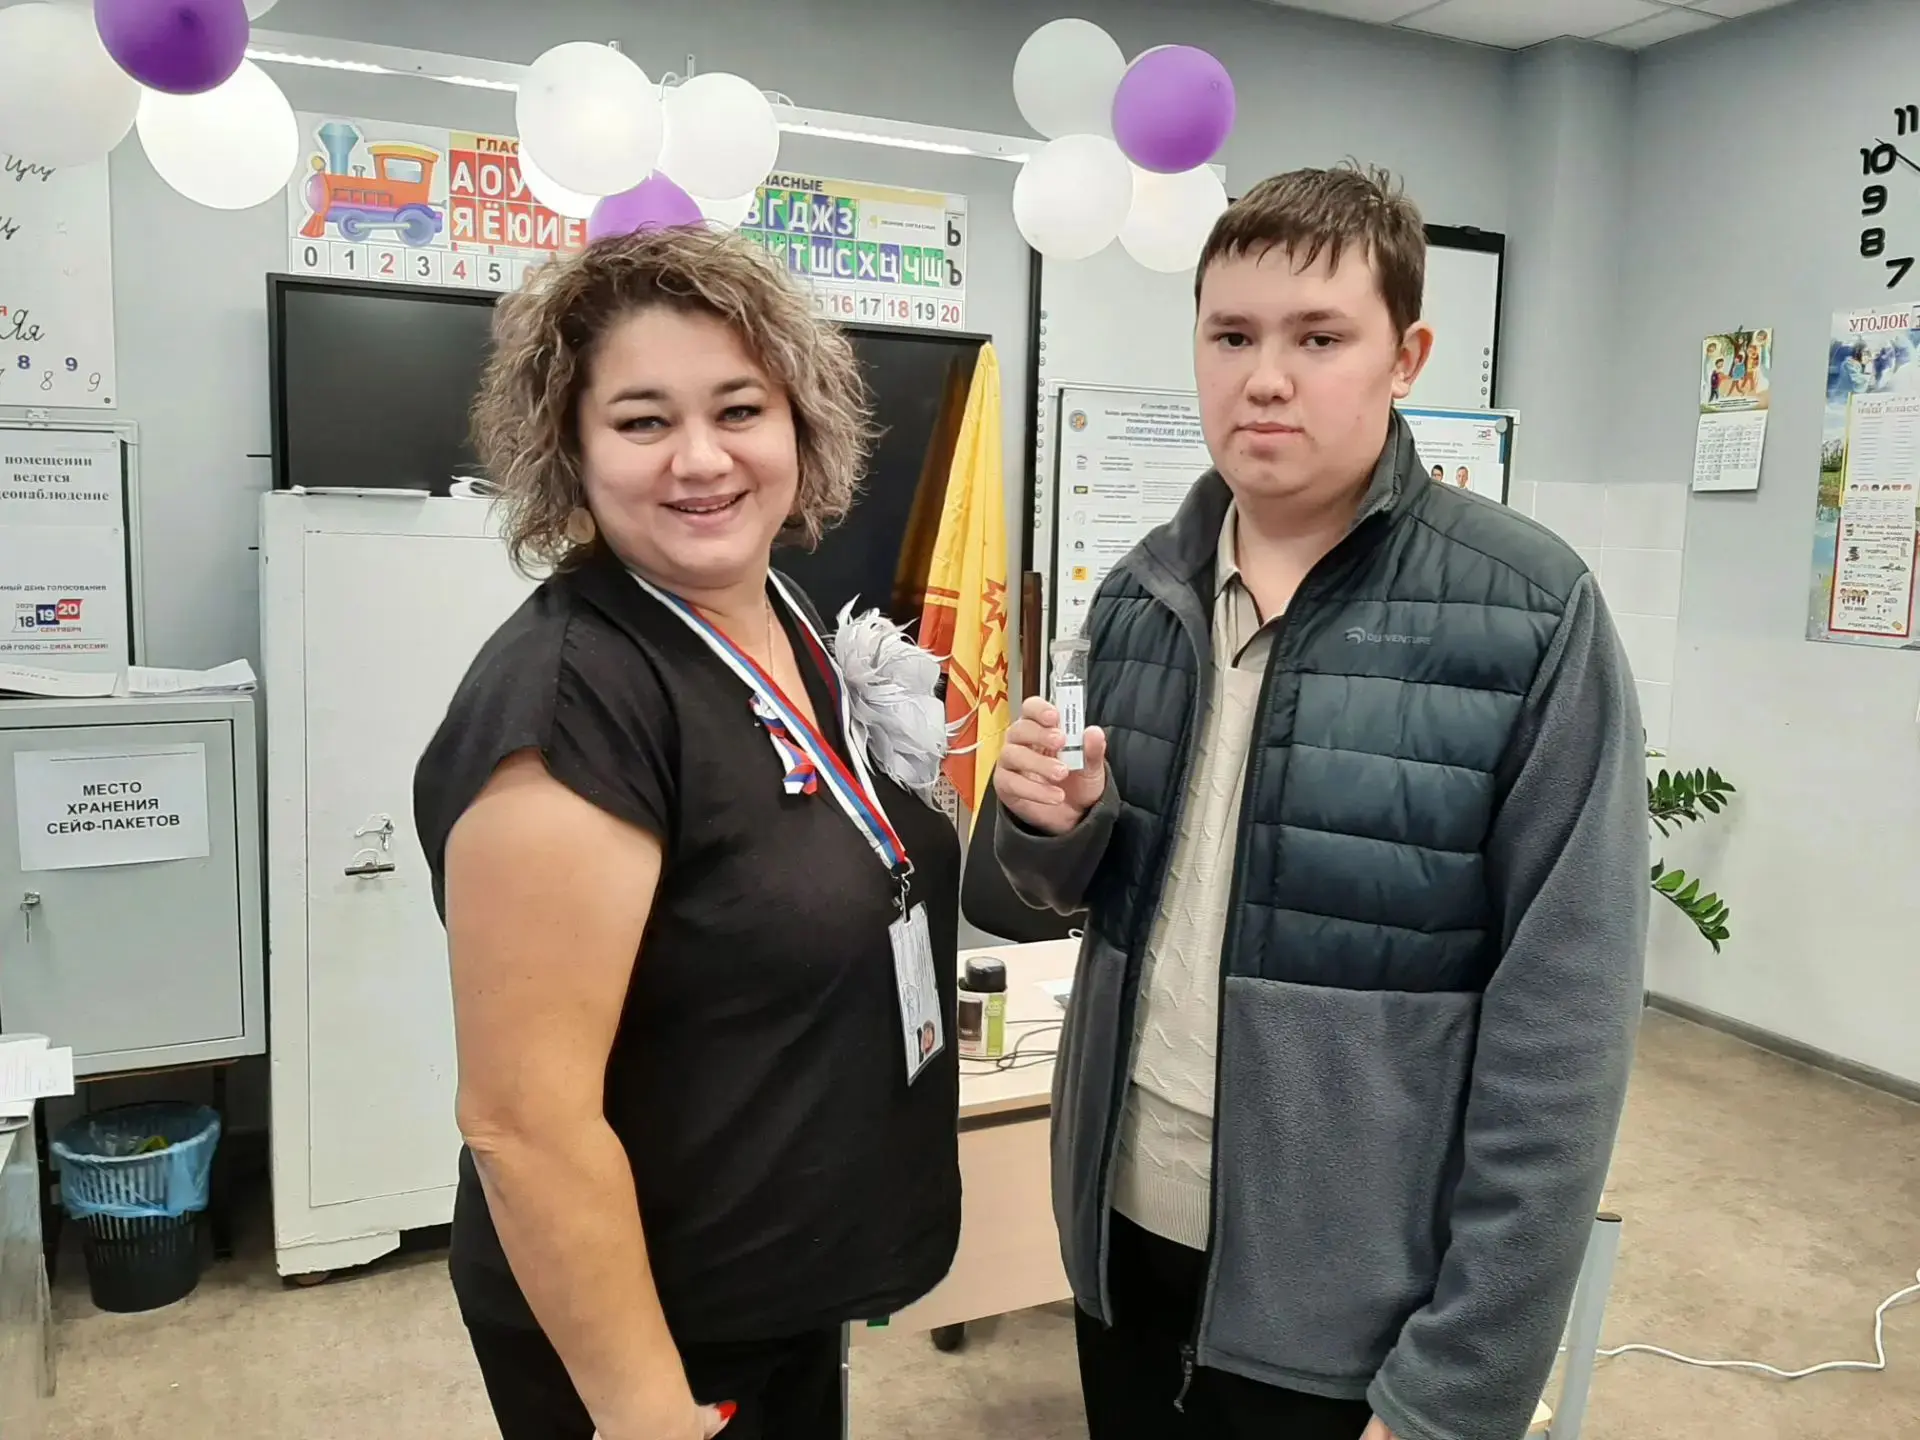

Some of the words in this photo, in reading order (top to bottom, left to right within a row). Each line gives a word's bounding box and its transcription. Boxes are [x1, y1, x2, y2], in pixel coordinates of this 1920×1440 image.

[1894, 104, 1919, 136] 11
[476, 138, 519, 155] ГЛАС
[1860, 143, 1897, 175] 10
[765, 175, 823, 192] АСНЫЕ
[1861, 184, 1888, 216] 9
[1860, 227, 1885, 257] 8
[1885, 257, 1915, 289] 7
[831, 295, 854, 314] 16
[859, 297, 881, 316] 17
[888, 299, 909, 318] 18
[915, 302, 936, 321] 19
[941, 304, 960, 324] 20
[1849, 313, 1909, 332] УГОЛОК
[18, 354, 31, 369] 8
[65, 357, 78, 371] 9
[40, 370, 54, 391] 8
[87, 372, 101, 392] 9
[5, 456, 92, 467] помещении
[13, 473, 71, 484] ведется
[0, 488, 109, 501] еонаблюдение
[19, 616, 36, 628] 18
[38, 608, 56, 622] 19
[58, 603, 79, 616] 20
[83, 782, 142, 797] МЕСТО
[66, 798, 159, 816] ХРАНЕНИЯ
[47, 814, 180, 835] СЕЙФ-ПАКЕТОВ
